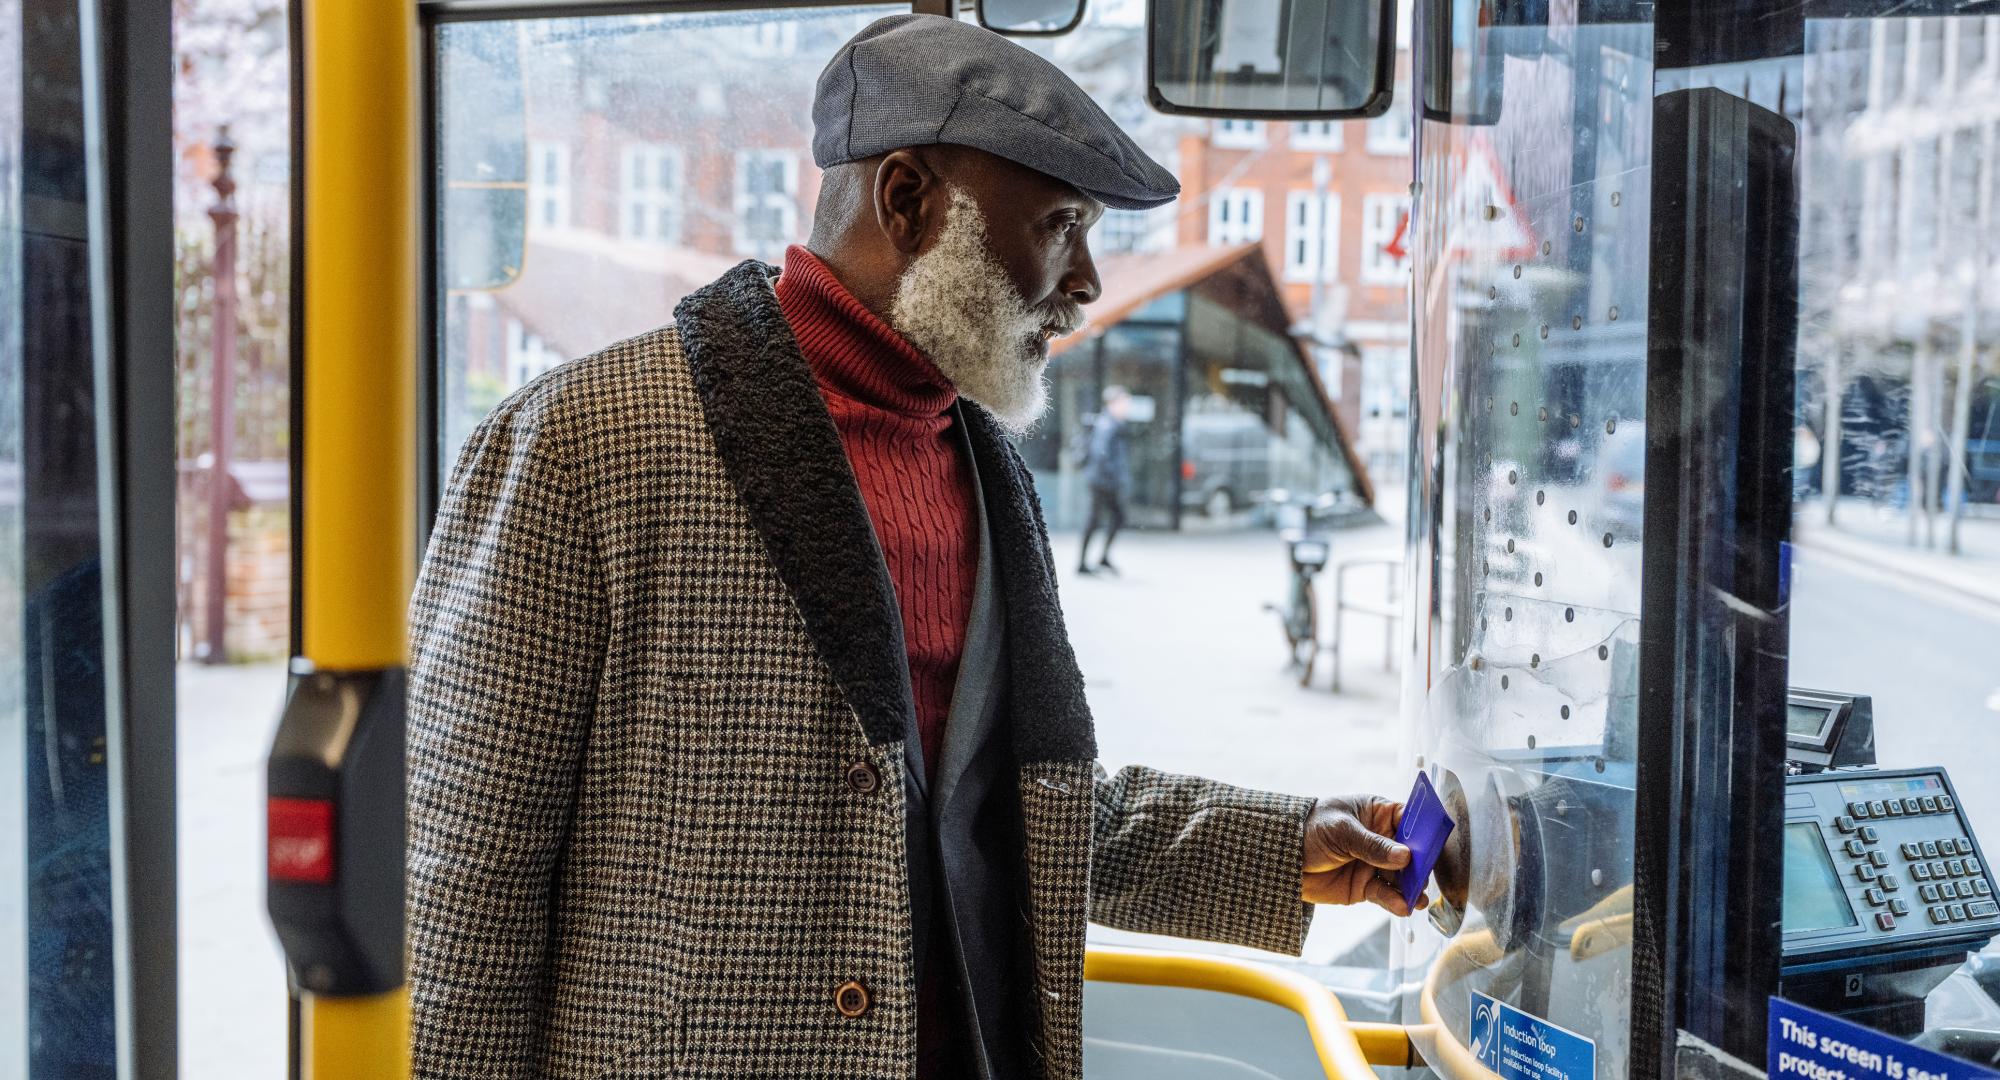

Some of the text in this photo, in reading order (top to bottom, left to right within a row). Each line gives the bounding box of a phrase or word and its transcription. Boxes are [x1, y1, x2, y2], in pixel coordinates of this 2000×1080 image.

[1503, 1021, 1556, 1059] Induction loop
[1779, 1017, 1818, 1049] This
[1819, 1036, 1883, 1073] screen
[1886, 1054, 1904, 1080] is
[1503, 1044, 1510, 1054] An
[1510, 1047, 1533, 1065] induction
[1532, 1057, 1545, 1072] loop
[1545, 1063, 1564, 1080] facility
[1503, 1056, 1523, 1072] available
[1523, 1064, 1531, 1077] for
